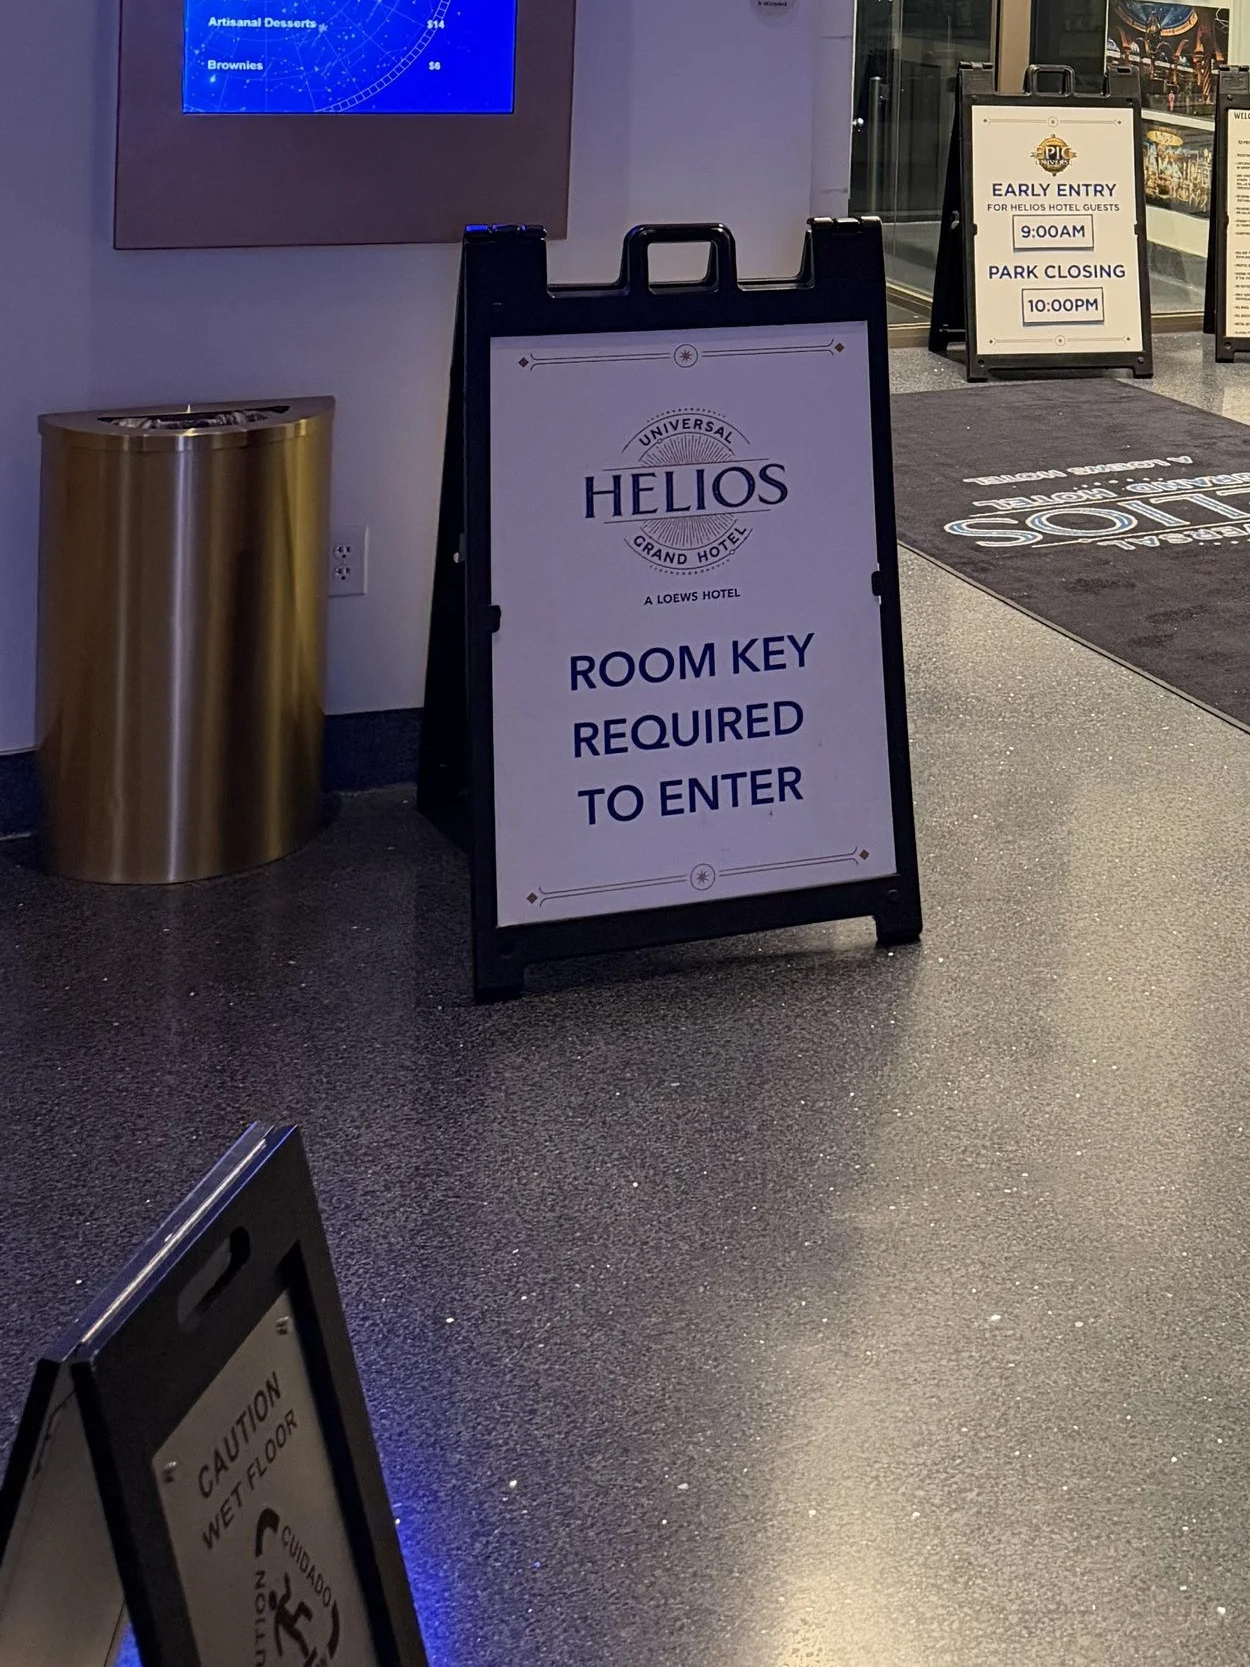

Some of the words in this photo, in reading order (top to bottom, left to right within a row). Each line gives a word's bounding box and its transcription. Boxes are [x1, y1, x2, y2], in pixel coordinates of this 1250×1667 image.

[208, 17, 262, 29] Artisanal
[264, 18, 316, 29] Desserts
[427, 20, 445, 29] $14
[208, 60, 263, 71] Brownies
[1036, 145, 1073, 160] EPIC
[992, 183, 1050, 197] EARLY
[1057, 184, 1117, 197] ENTRY
[1083, 204, 1120, 212] GUESTS
[1021, 225, 1085, 239] 9:00AM
[989, 265, 1038, 279] PARK
[1045, 264, 1126, 278] CLOSING
[1028, 299, 1099, 312] 10:00PM
[638, 418, 735, 448] UNIVERSAL
[1166, 455, 1193, 464] A
[963, 469, 1068, 486] HOTEL
[584, 463, 789, 519] HELIOS
[972, 487, 1117, 512] HOTEL
[633, 533, 687, 566] GRAND
[697, 524, 748, 564] HOTEL
[644, 595, 653, 606] A
[657, 591, 698, 605] LOEWS
[702, 588, 741, 600] HOTEL
[570, 643, 716, 691] ROOM
[732, 632, 815, 674] KEY
[574, 700, 804, 758] REQUIRED
[577, 784, 644, 825] TO
[659, 766, 804, 817] ENTER
[199, 1372, 282, 1498] CAUTION
[202, 1485, 245, 1549] WET
[247, 1409, 299, 1488] FLOOR
[282, 1525, 331, 1608] CUIDADO
[255, 1570, 266, 1667] UTION
